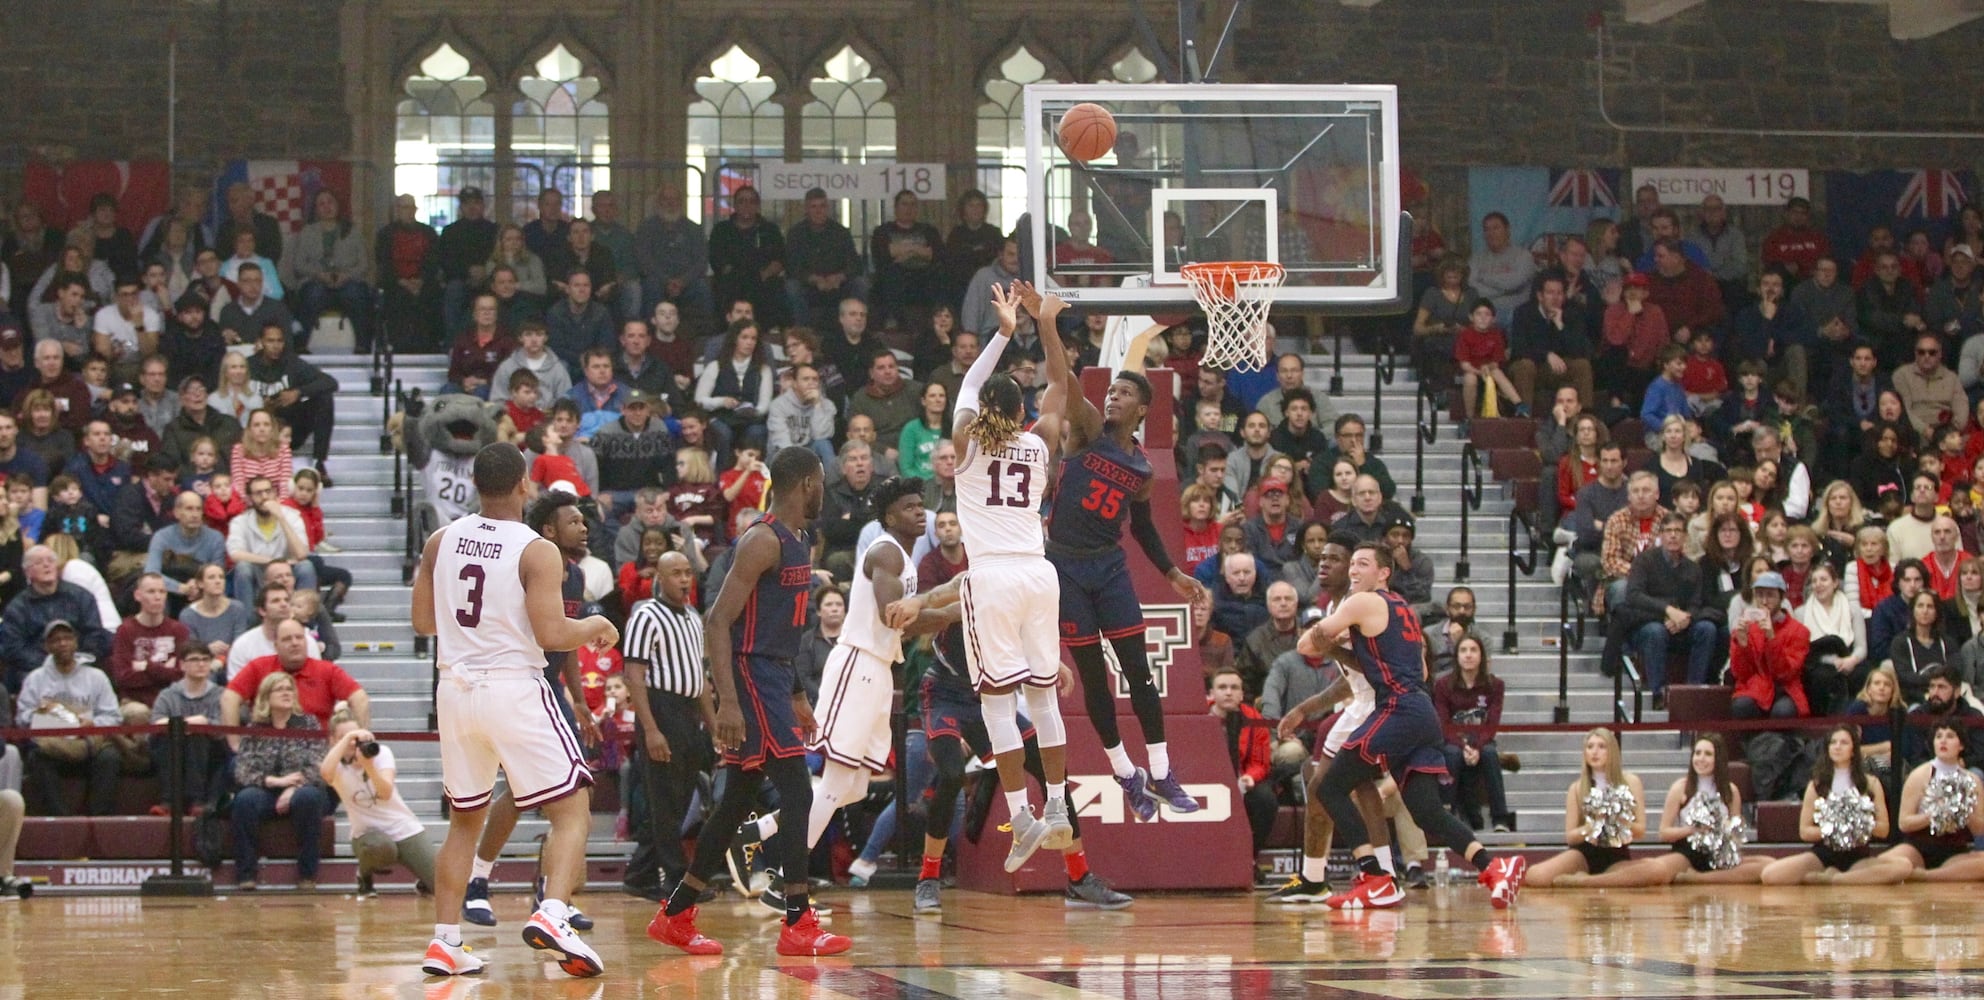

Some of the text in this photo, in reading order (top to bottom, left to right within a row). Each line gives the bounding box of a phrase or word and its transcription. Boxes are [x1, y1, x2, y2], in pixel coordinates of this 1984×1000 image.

[773, 167, 932, 194] SECTION 118
[1746, 172, 1796, 199] 119
[438, 477, 466, 504] 20
[986, 459, 1031, 508] 13
[1081, 479, 1126, 519] 35
[456, 537, 502, 559] HONOR
[456, 563, 486, 628] 3
[792, 591, 809, 626] 11
[64, 867, 154, 885] FORDHAM
